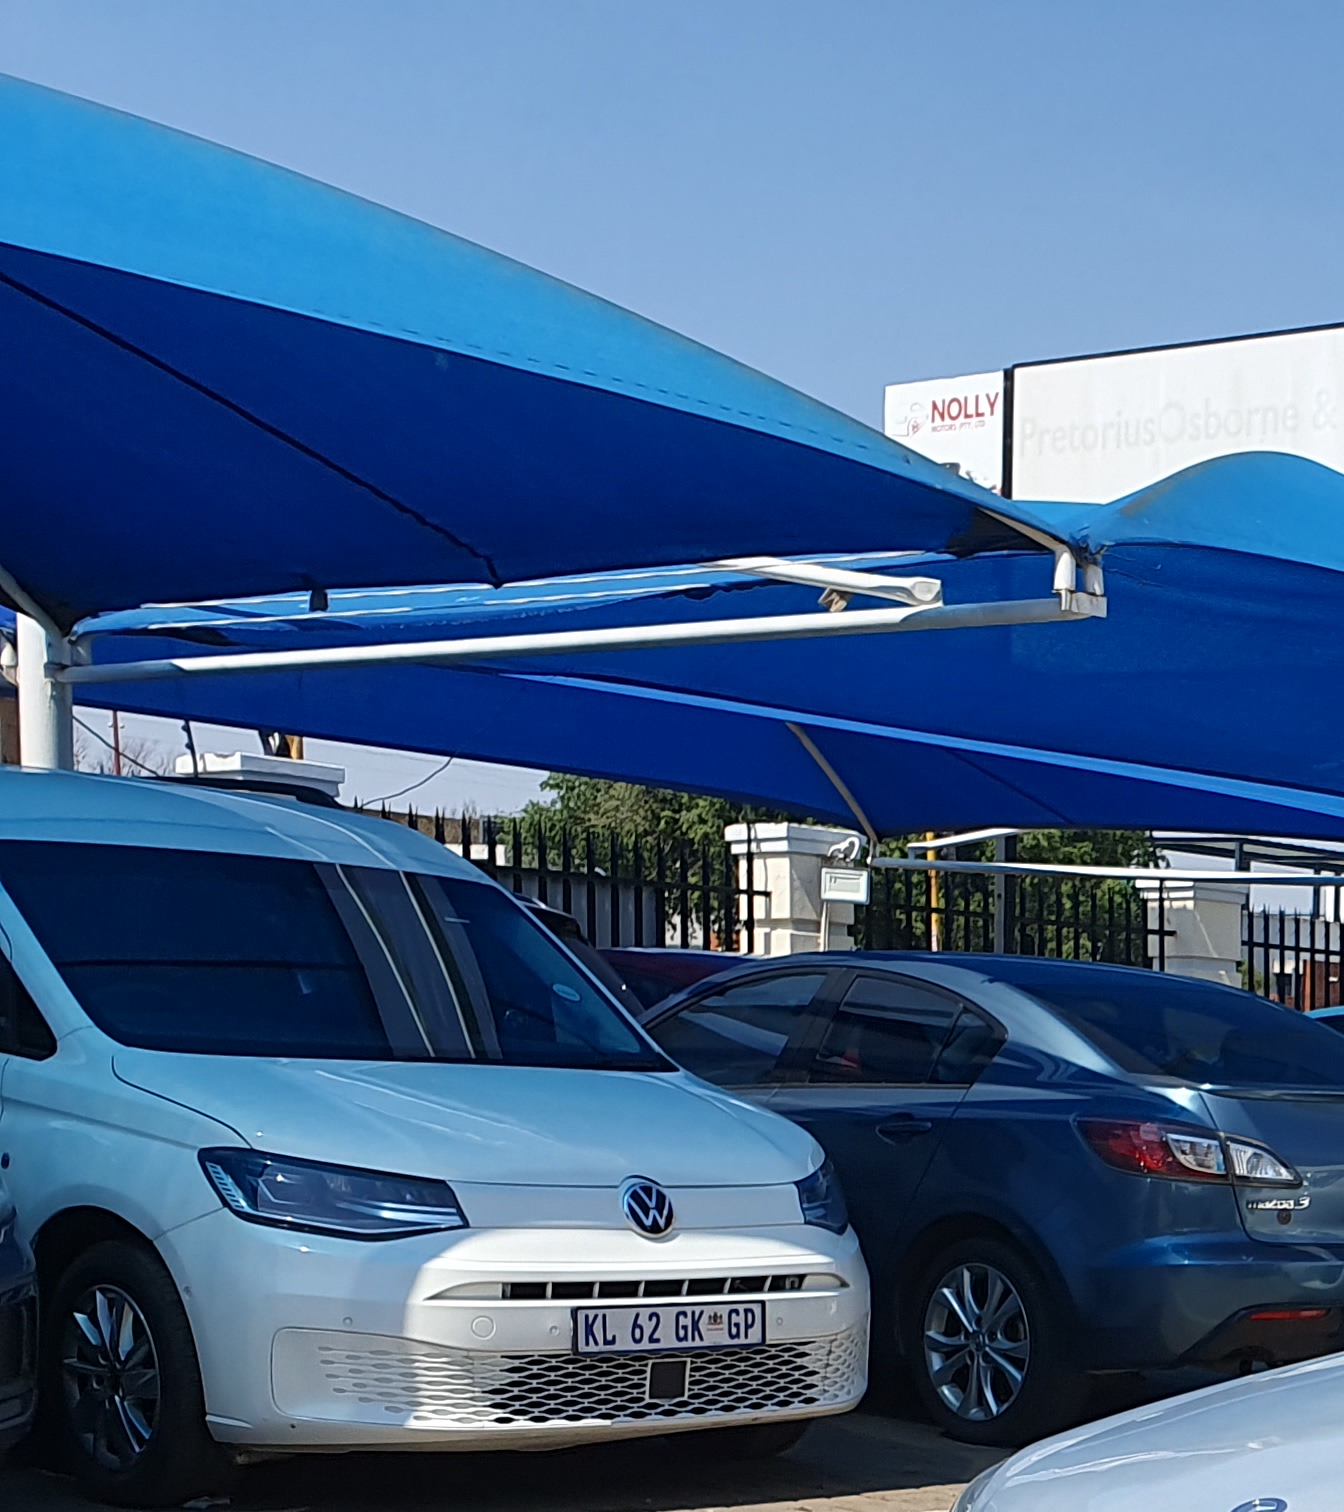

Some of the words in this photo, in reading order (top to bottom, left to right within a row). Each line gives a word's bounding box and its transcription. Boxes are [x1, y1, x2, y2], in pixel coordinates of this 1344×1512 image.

[930, 391, 999, 424] NOLLY
[1312, 387, 1338, 432] &
[584, 1313, 617, 1347] KL
[631, 1311, 661, 1344] 62
[675, 1309, 704, 1342] GK
[727, 1307, 756, 1340] GP
